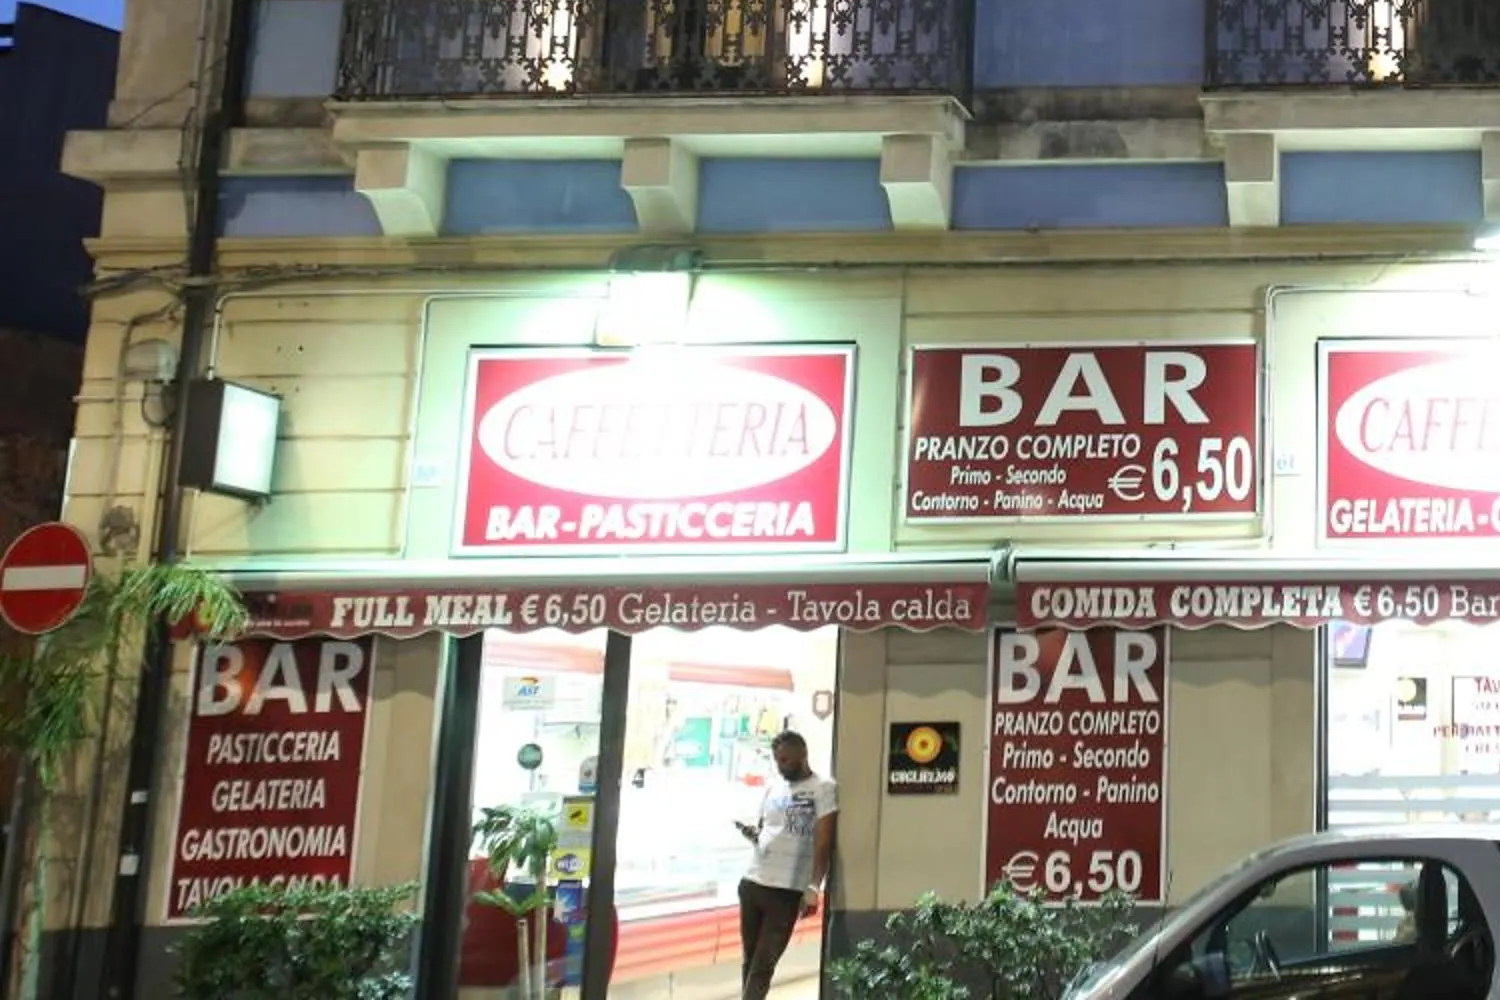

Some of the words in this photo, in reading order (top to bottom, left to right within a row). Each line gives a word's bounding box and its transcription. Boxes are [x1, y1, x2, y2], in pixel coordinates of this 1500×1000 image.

[959, 351, 1210, 427] BAR
[503, 401, 810, 460] CAFFETERIA
[915, 435, 1009, 460] PRANZO
[1016, 433, 1141, 460] COMPLETO
[951, 464, 991, 485] Primo
[1005, 464, 1067, 485] Secondo
[911, 491, 979, 511] Contorno
[993, 489, 1043, 510] Panino
[1057, 489, 1104, 512] Acqua
[330, 596, 416, 628] FULL
[423, 594, 513, 626] MEAL
[618, 592, 757, 625] Gelateria
[788, 588, 882, 623] Tavola
[891, 588, 971, 622] calda
[1031, 587, 1157, 619] COMIDA
[1170, 585, 1344, 619] COMPLETA
[196, 641, 364, 717] BAR
[998, 631, 1160, 705] BAR
[994, 711, 1063, 736] PRANZO
[1069, 710, 1160, 735] COMPLETO
[206, 731, 340, 765] PASTICCERIA
[1002, 740, 1054, 769] Primo
[1073, 740, 1150, 769] Secondo
[211, 778, 326, 813] GELATERIA
[991, 775, 1077, 805] Contorno
[1096, 775, 1159, 803] Panino
[181, 825, 346, 861] GASTRONOMIA
[1043, 811, 1103, 845] Acqua
